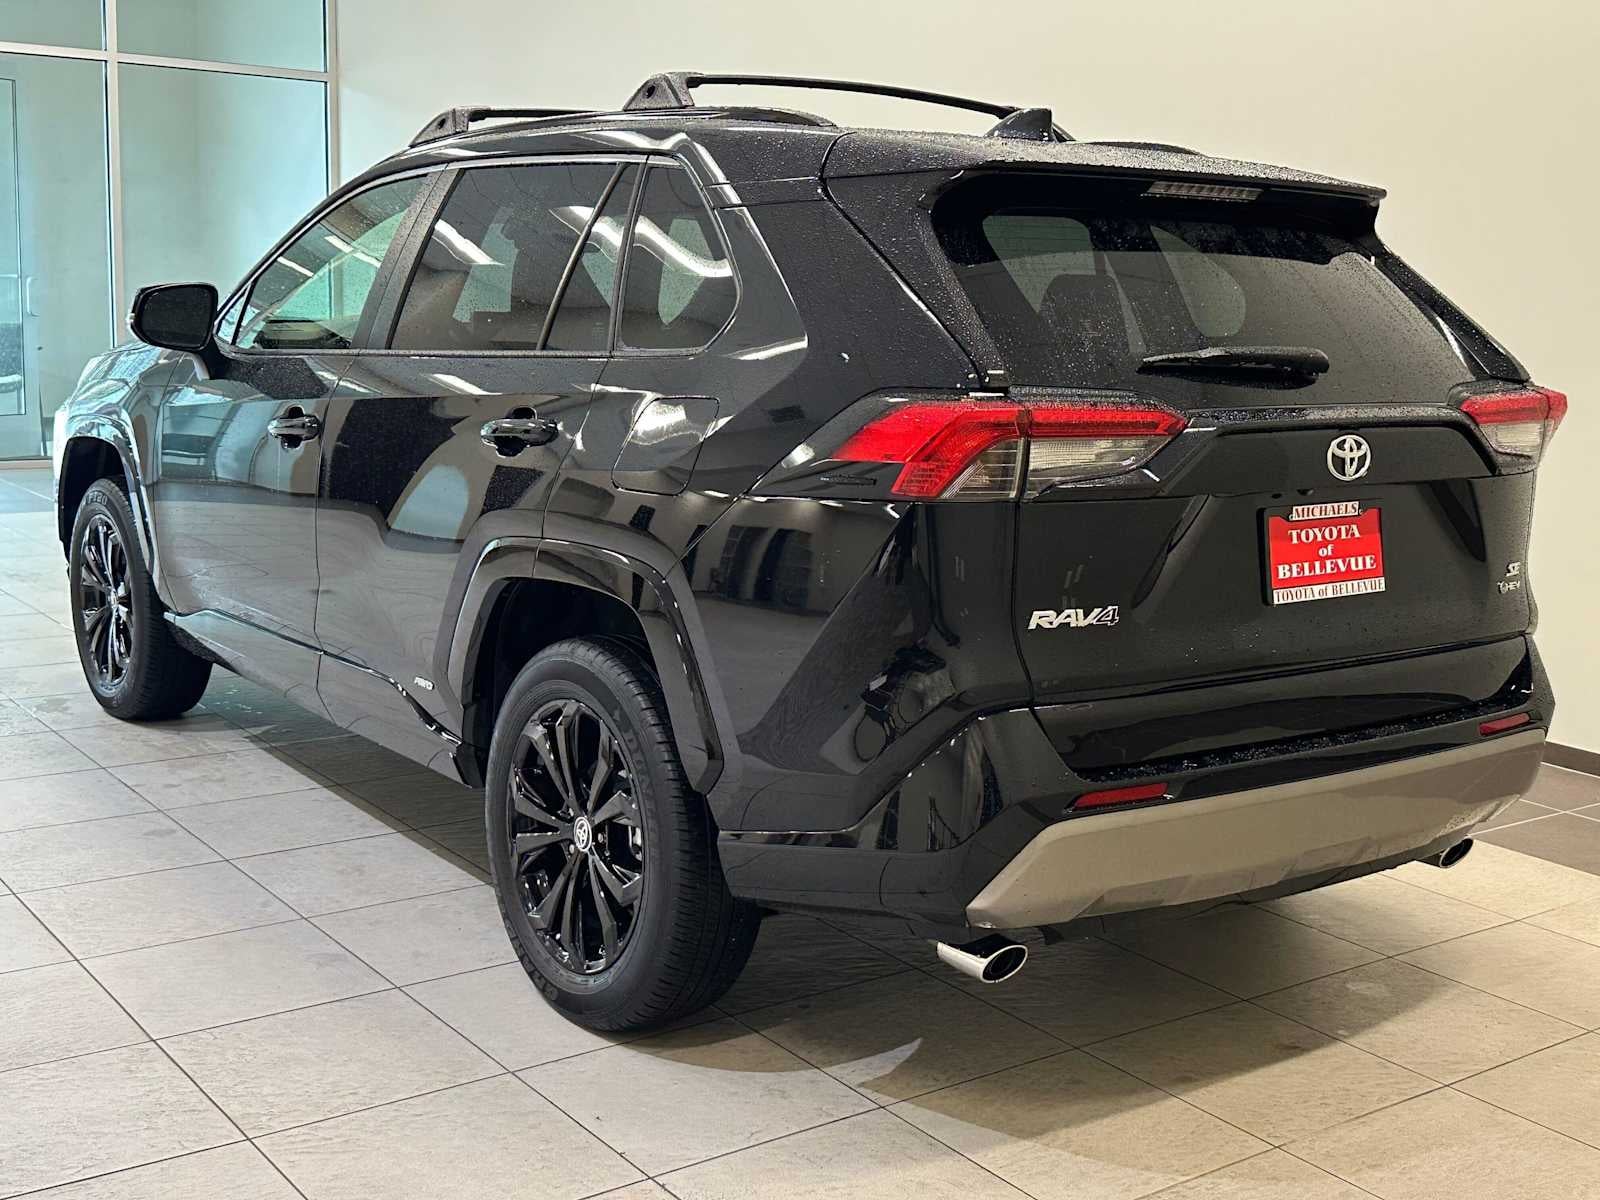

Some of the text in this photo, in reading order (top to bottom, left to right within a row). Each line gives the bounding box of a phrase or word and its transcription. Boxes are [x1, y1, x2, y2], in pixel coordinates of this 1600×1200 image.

[1294, 502, 1358, 519] MICHAELS
[1288, 524, 1361, 544] TOYOTA
[1318, 544, 1335, 557] of
[1276, 554, 1377, 580] BELLEVUE
[1274, 578, 1384, 603] TOYOTA of BELLEVUE
[1027, 605, 1120, 630] RAV4
